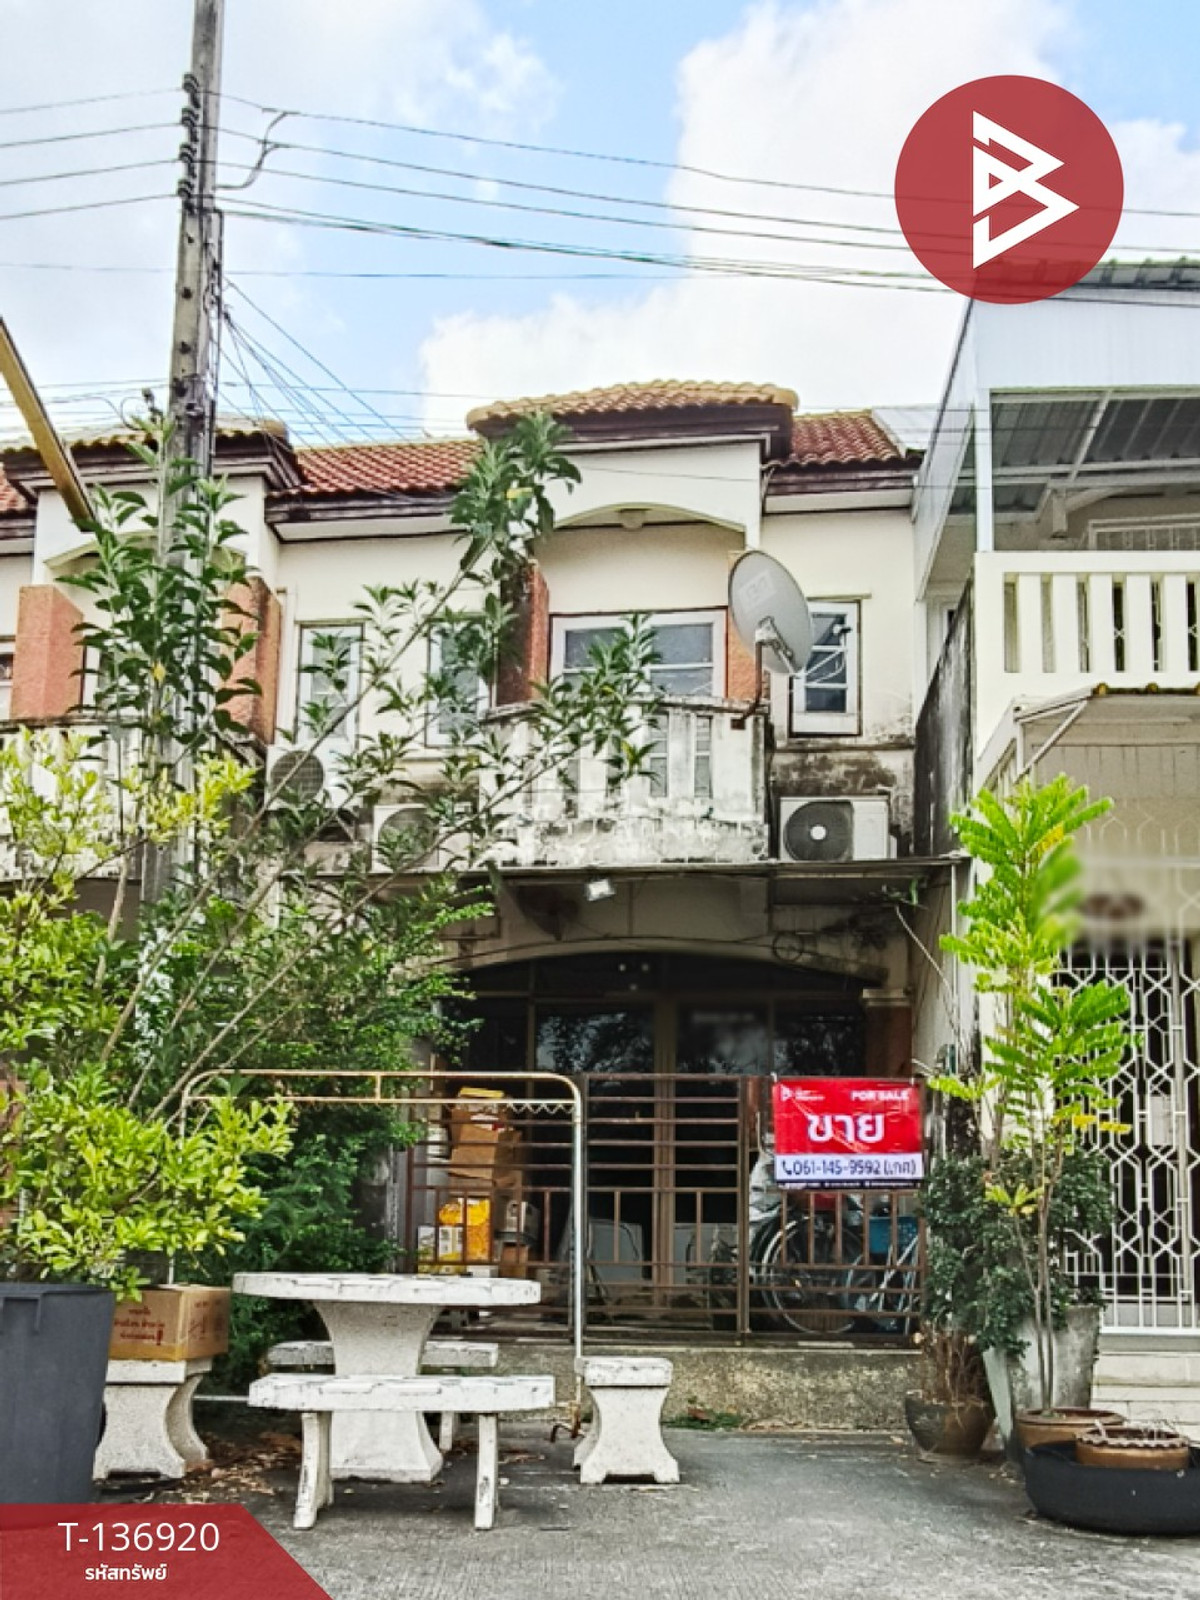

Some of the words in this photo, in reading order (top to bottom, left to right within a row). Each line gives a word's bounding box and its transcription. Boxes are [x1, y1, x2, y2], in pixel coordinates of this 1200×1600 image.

[851, 1089, 875, 1101] FOR
[878, 1089, 909, 1100] SALE
[807, 1114, 885, 1143] ขาย
